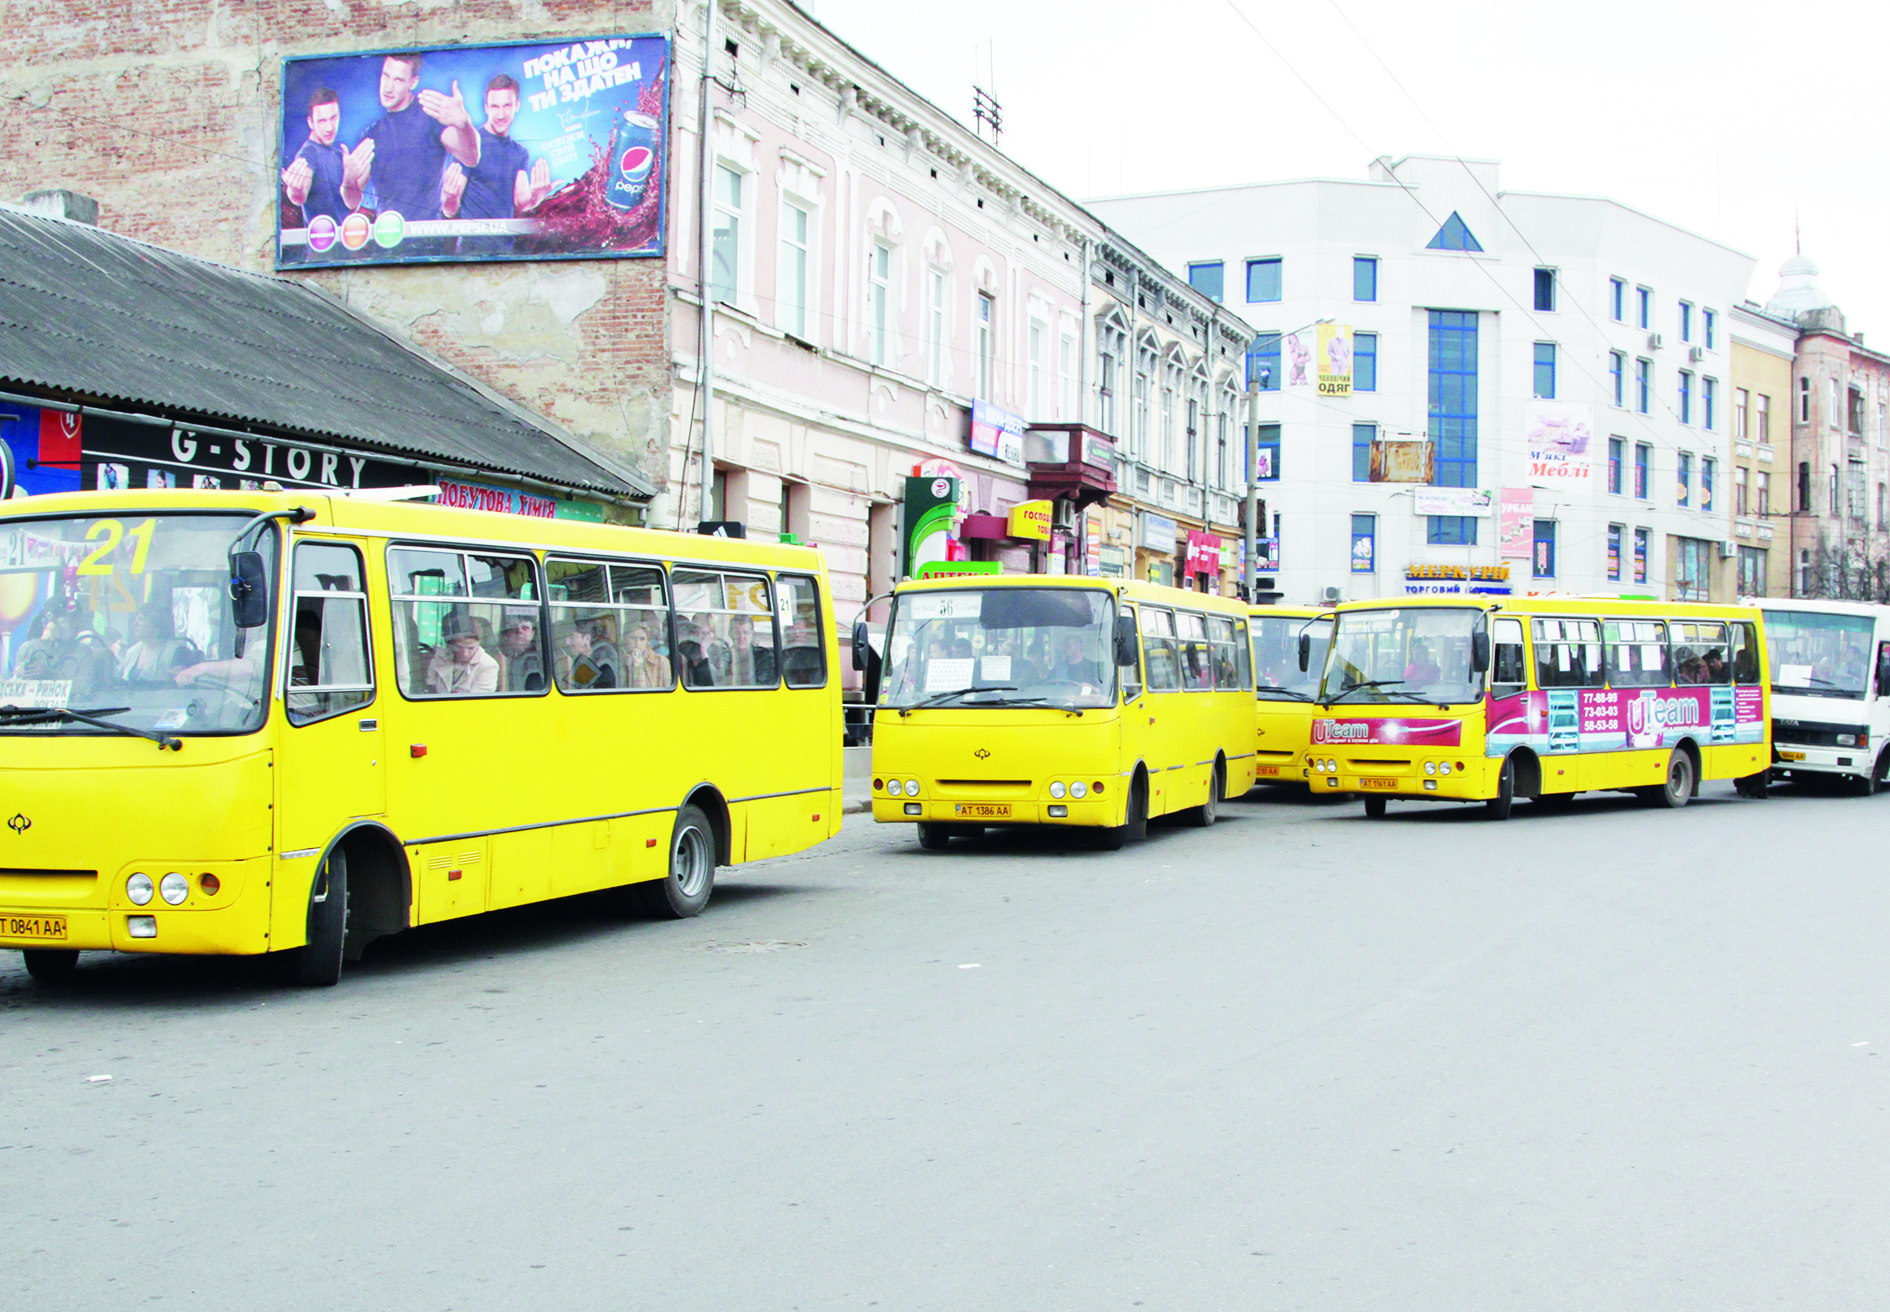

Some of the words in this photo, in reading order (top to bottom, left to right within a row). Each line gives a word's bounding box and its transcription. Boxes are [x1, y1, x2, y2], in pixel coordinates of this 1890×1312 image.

[543, 65, 576, 90] НА
[576, 51, 618, 79] ЩО
[528, 88, 557, 112] ТИ
[558, 61, 641, 102] ЗДАТЕН
[410, 221, 508, 236] WWW.PEPSI.UA
[1318, 382, 1351, 394] ОДЯГ
[1529, 451, 1566, 461] М'які
[1528, 462, 1590, 478] Меблі
[437, 480, 512, 514] ПОБУТОВА
[516, 494, 557, 519] ХІМІЯ
[9, 532, 25, 566] 21
[76, 518, 156, 575] 21
[1408, 561, 1511, 580] МЕРКУРІЙ
[1405, 584, 1461, 594] ТОРГОВИЙ
[780, 598, 790, 612] 21
[940, 599, 953, 616] 56
[35, 683, 69, 697] РИНОК
[1583, 692, 1618, 703] 77-88-99
[1584, 706, 1618, 717] 73-03-03
[1314, 719, 1369, 744] UTeam
[1584, 719, 1618, 731] 58-53-58
[961, 806, 973, 815] AT
[976, 806, 995, 815] 1386
[997, 806, 1009, 815] AA
[11, 919, 39, 935] 0841
[44, 920, 62, 936] AA
